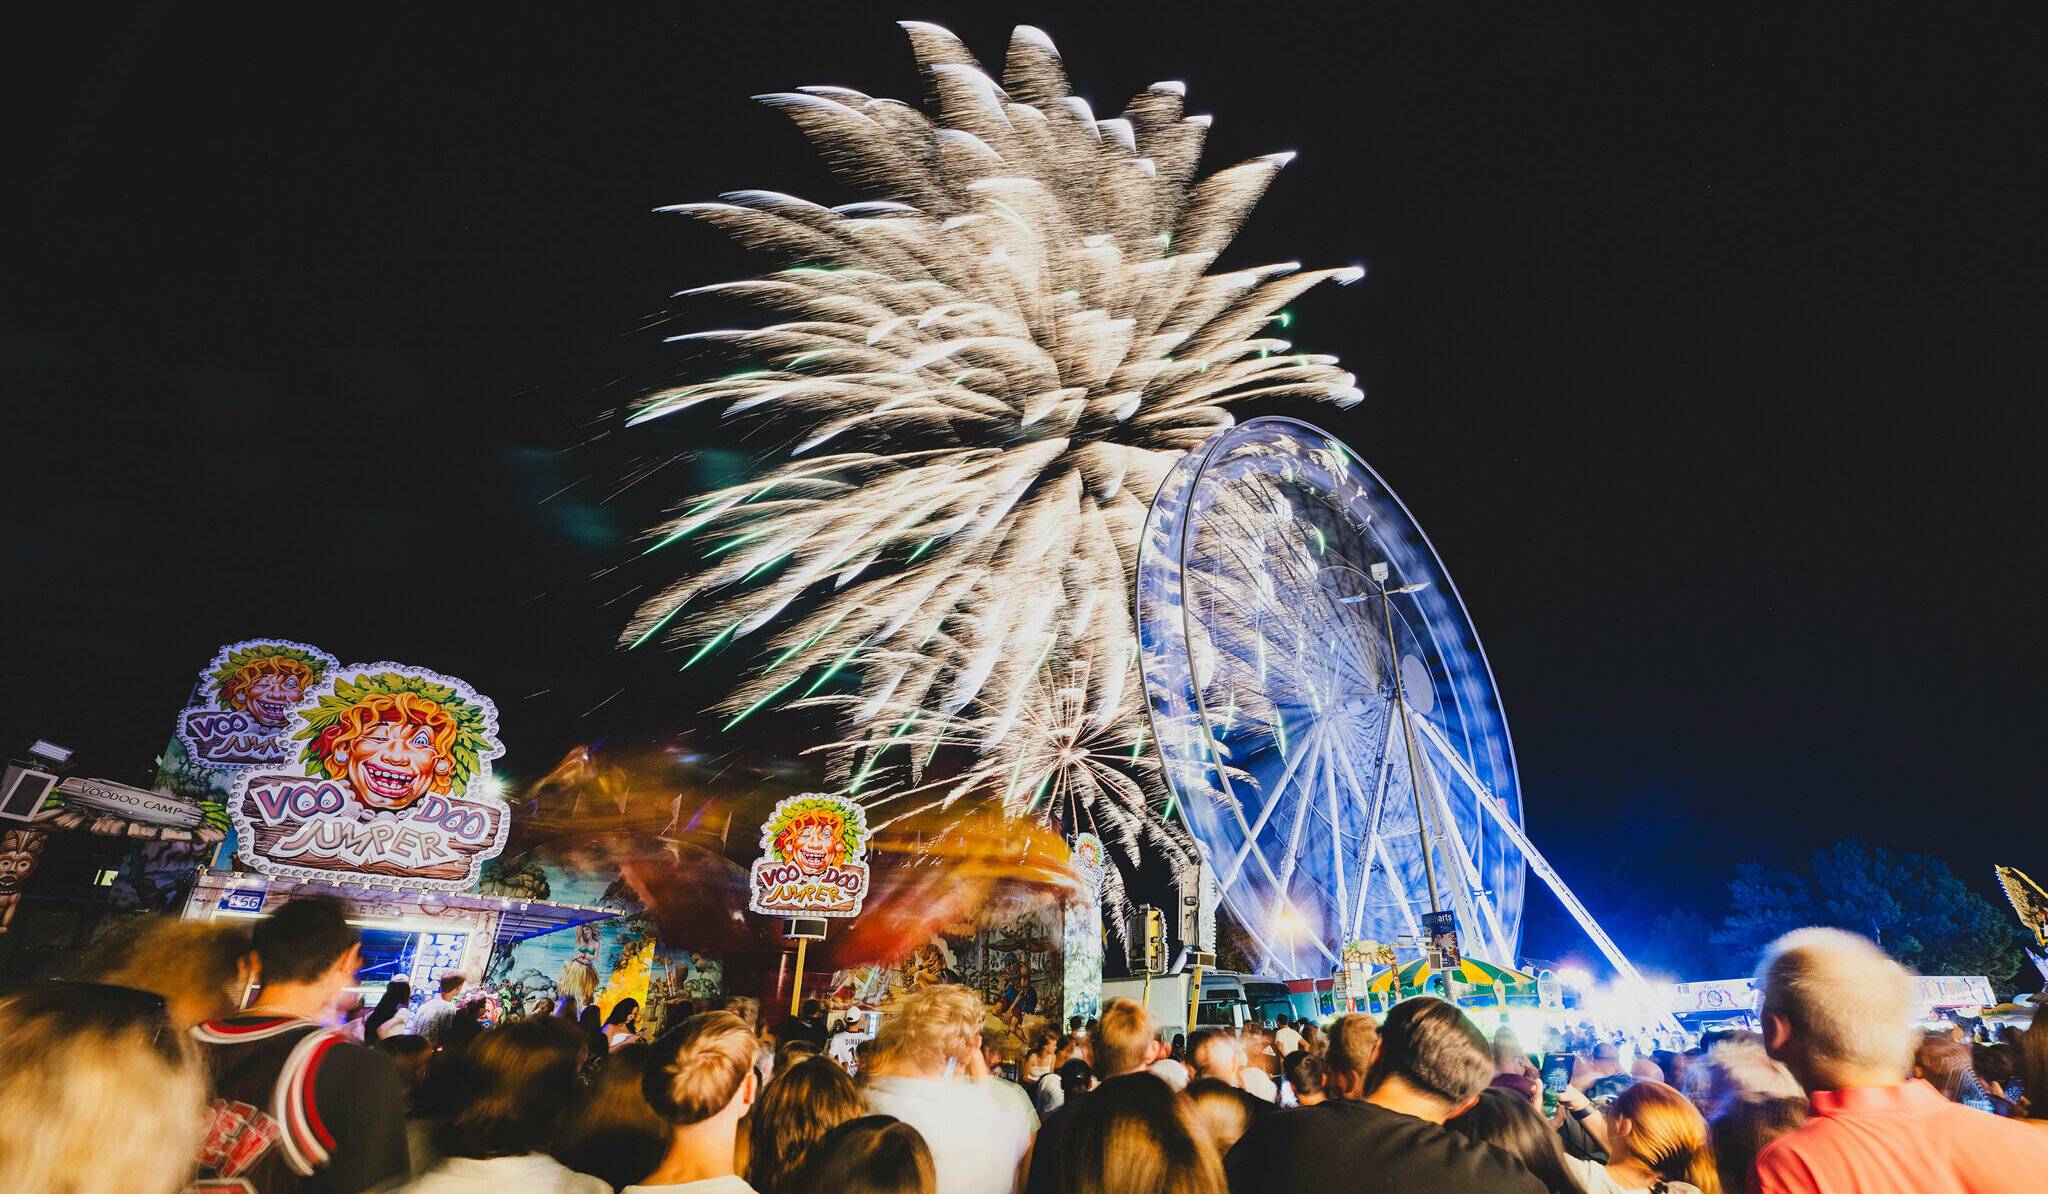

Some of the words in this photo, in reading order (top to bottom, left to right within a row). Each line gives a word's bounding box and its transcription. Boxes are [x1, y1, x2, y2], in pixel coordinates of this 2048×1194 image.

[193, 714, 248, 737] VOO
[214, 735, 280, 755] JUM
[81, 783, 139, 806] VOODOO
[143, 800, 182, 815] CAMP
[256, 782, 345, 819] VOO
[412, 795, 486, 839] DOO
[280, 818, 447, 862] JUMPER
[761, 864, 800, 886] VOO
[822, 867, 859, 890] DOO
[230, 895, 260, 908] 156
[767, 885, 844, 902] JUMPER
